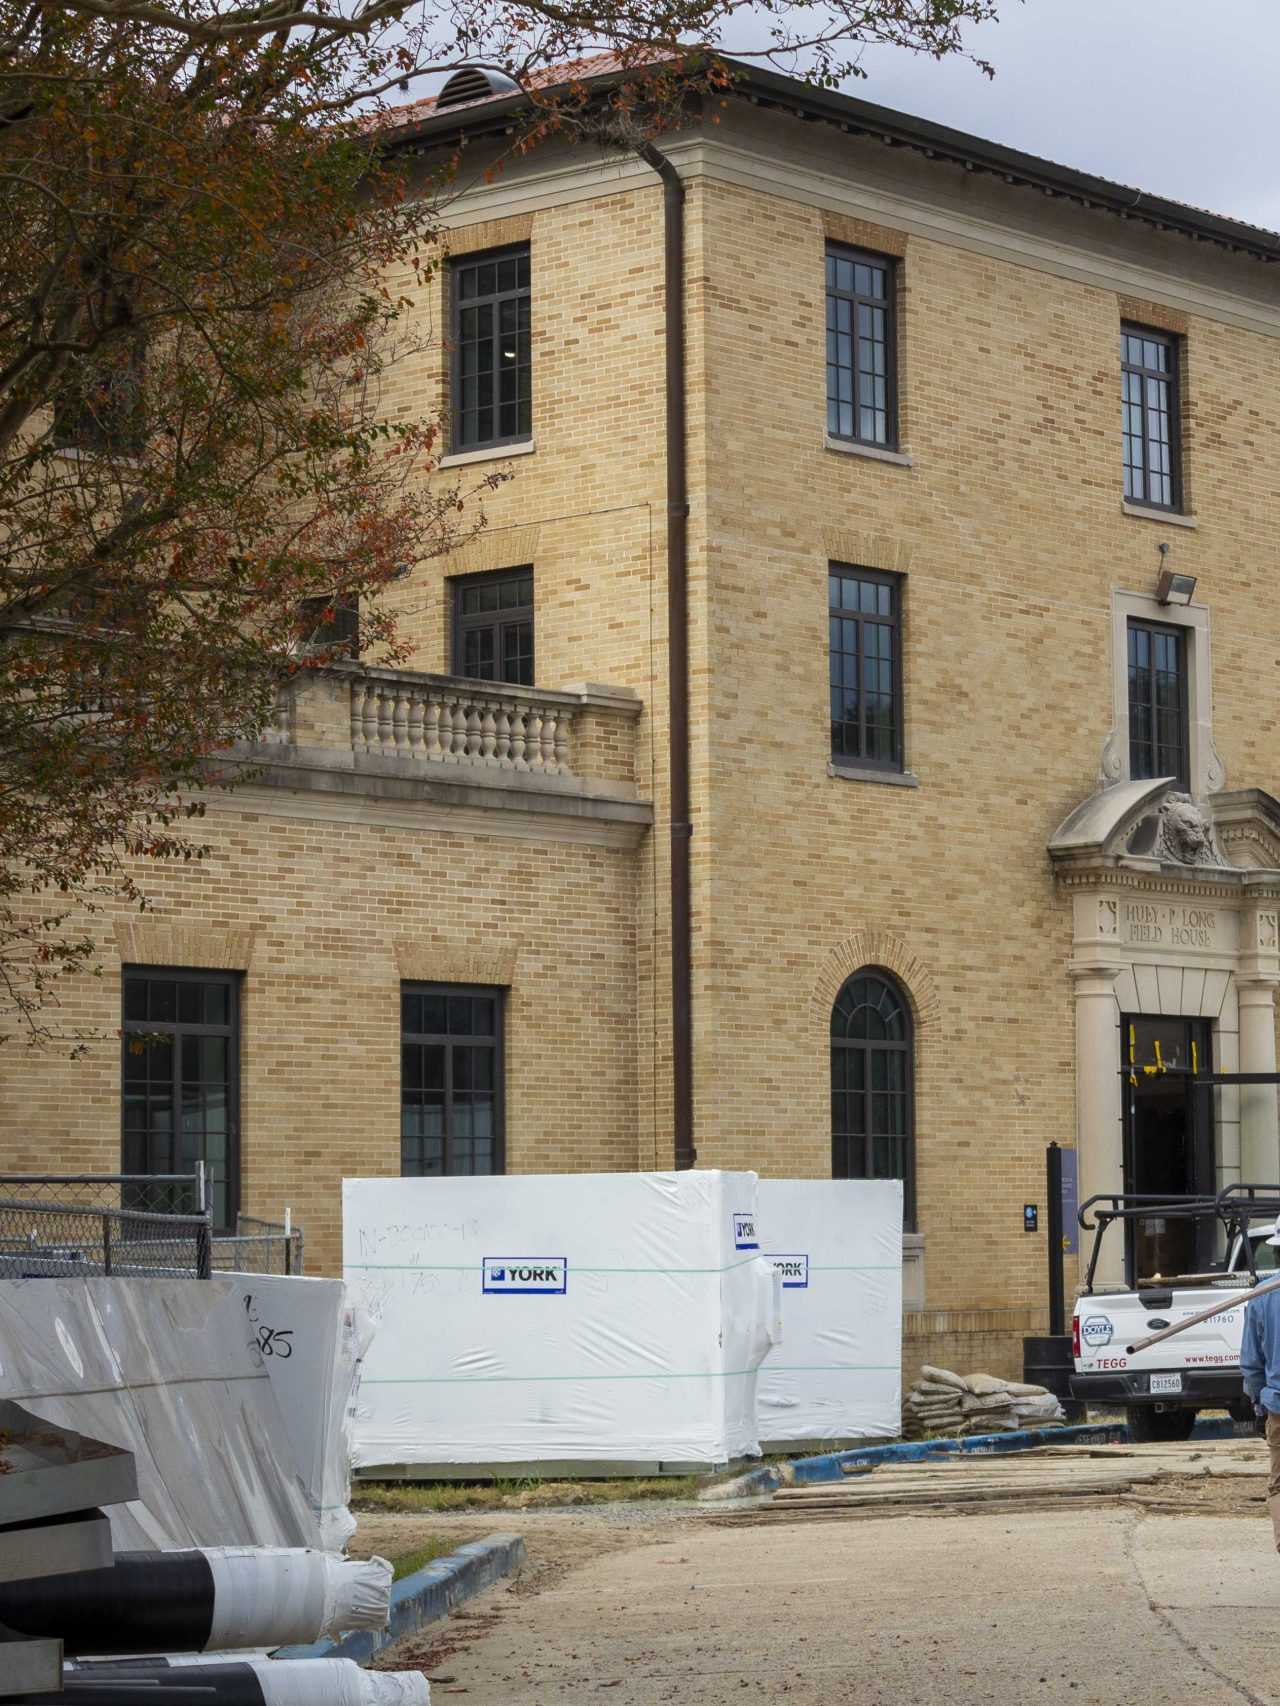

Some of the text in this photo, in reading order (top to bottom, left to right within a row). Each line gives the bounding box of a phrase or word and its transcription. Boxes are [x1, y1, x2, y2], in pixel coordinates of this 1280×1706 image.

[1126, 904, 1159, 923] HUEY
[1182, 908, 1215, 928] LONG
[1130, 924, 1211, 946] FIELD HOUSE
[508, 1266, 558, 1282] YORK
[773, 1262, 802, 1277] ORK
[1203, 1314, 1234, 1324] 11760
[1083, 1325, 1112, 1335] DOYLE
[1096, 1358, 1127, 1369] TEGG
[1185, 1354, 1240, 1364] www.tegg.com
